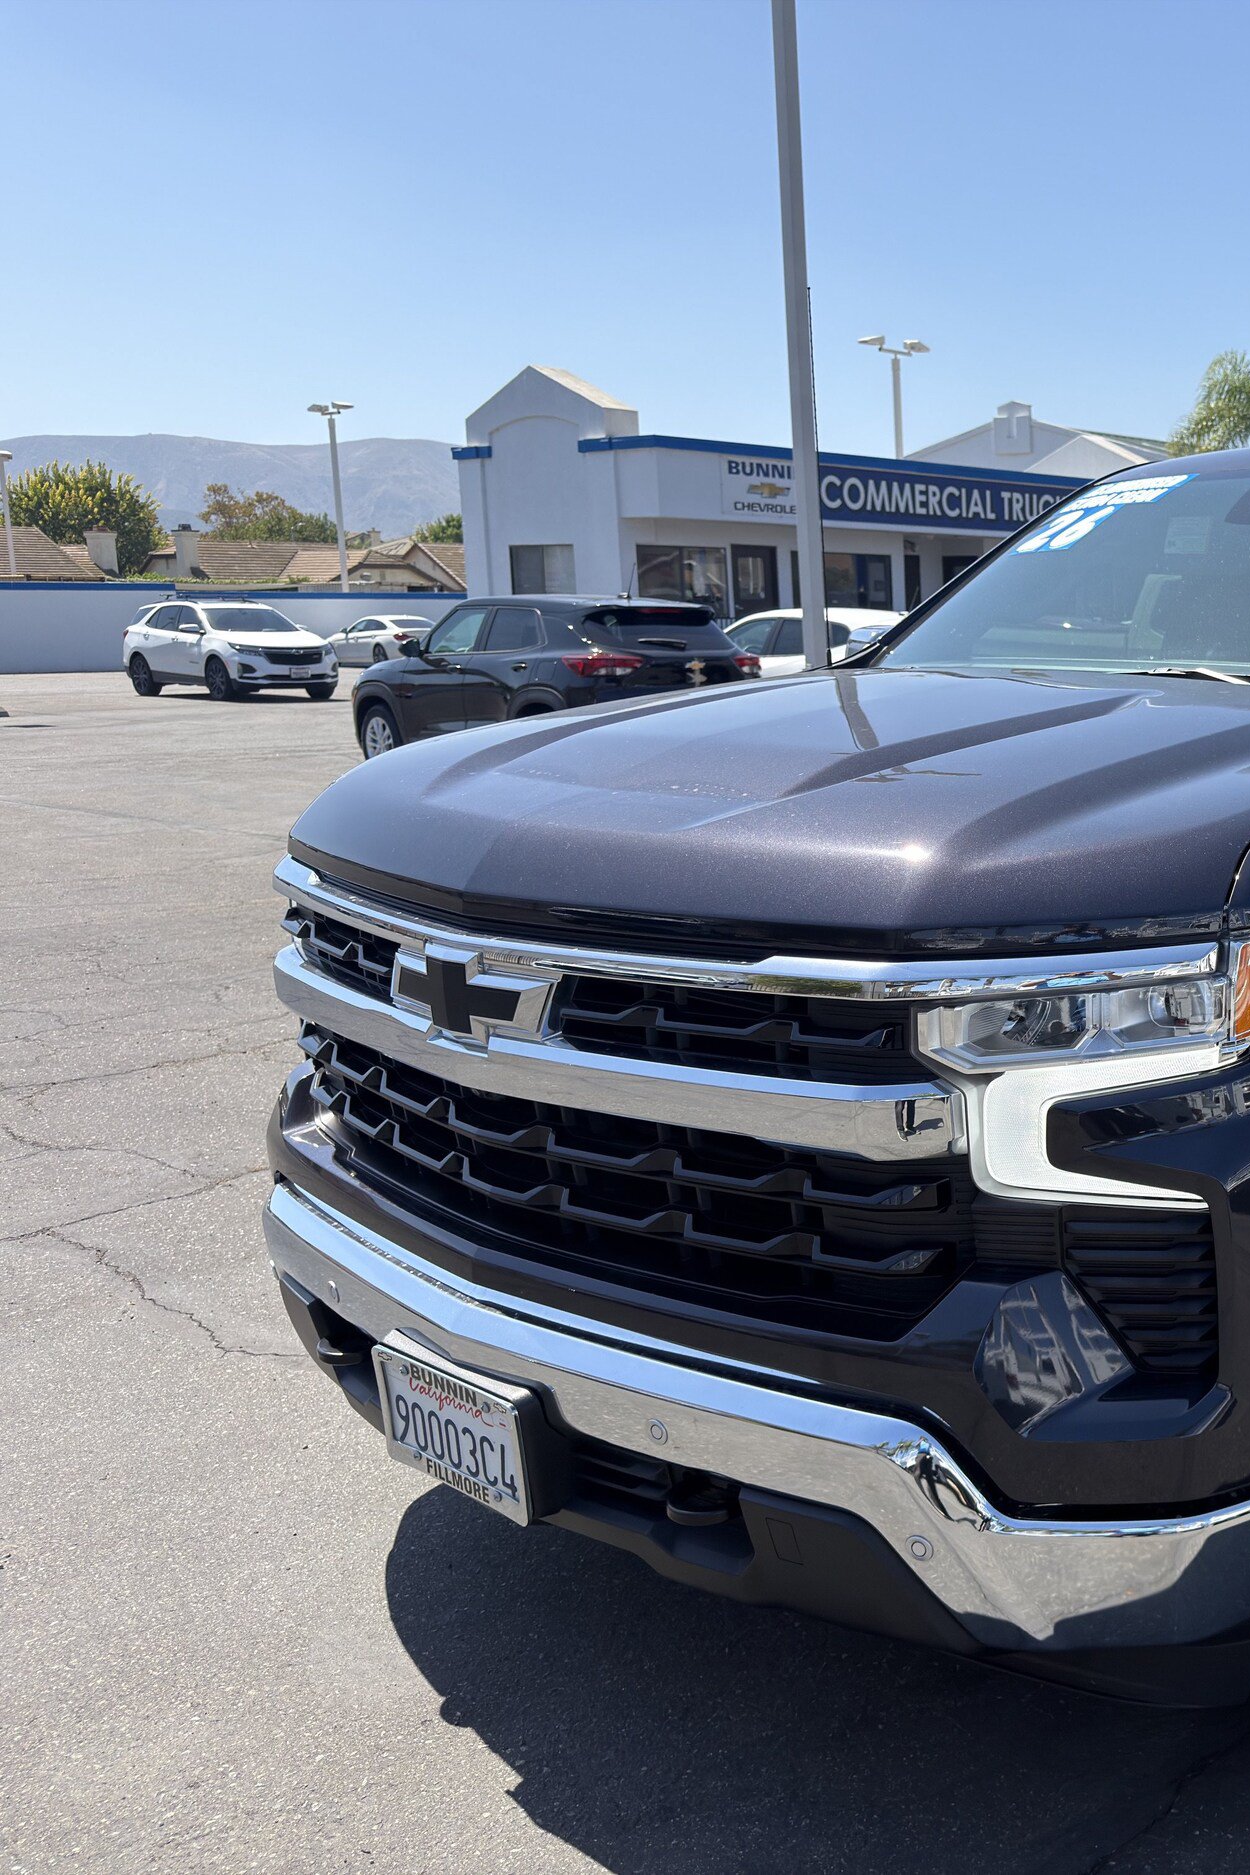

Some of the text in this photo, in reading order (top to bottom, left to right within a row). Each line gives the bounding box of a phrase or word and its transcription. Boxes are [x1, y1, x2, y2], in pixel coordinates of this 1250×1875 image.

[728, 460, 792, 479] BUNNI
[734, 501, 796, 515] CHEVROLE
[821, 475, 996, 520] COMMERCIAL
[1001, 491, 1062, 522] TRUC
[410, 1363, 478, 1407] BUNNIN
[395, 1394, 518, 1498] 90003C4
[426, 1457, 490, 1503] FILLMORE
